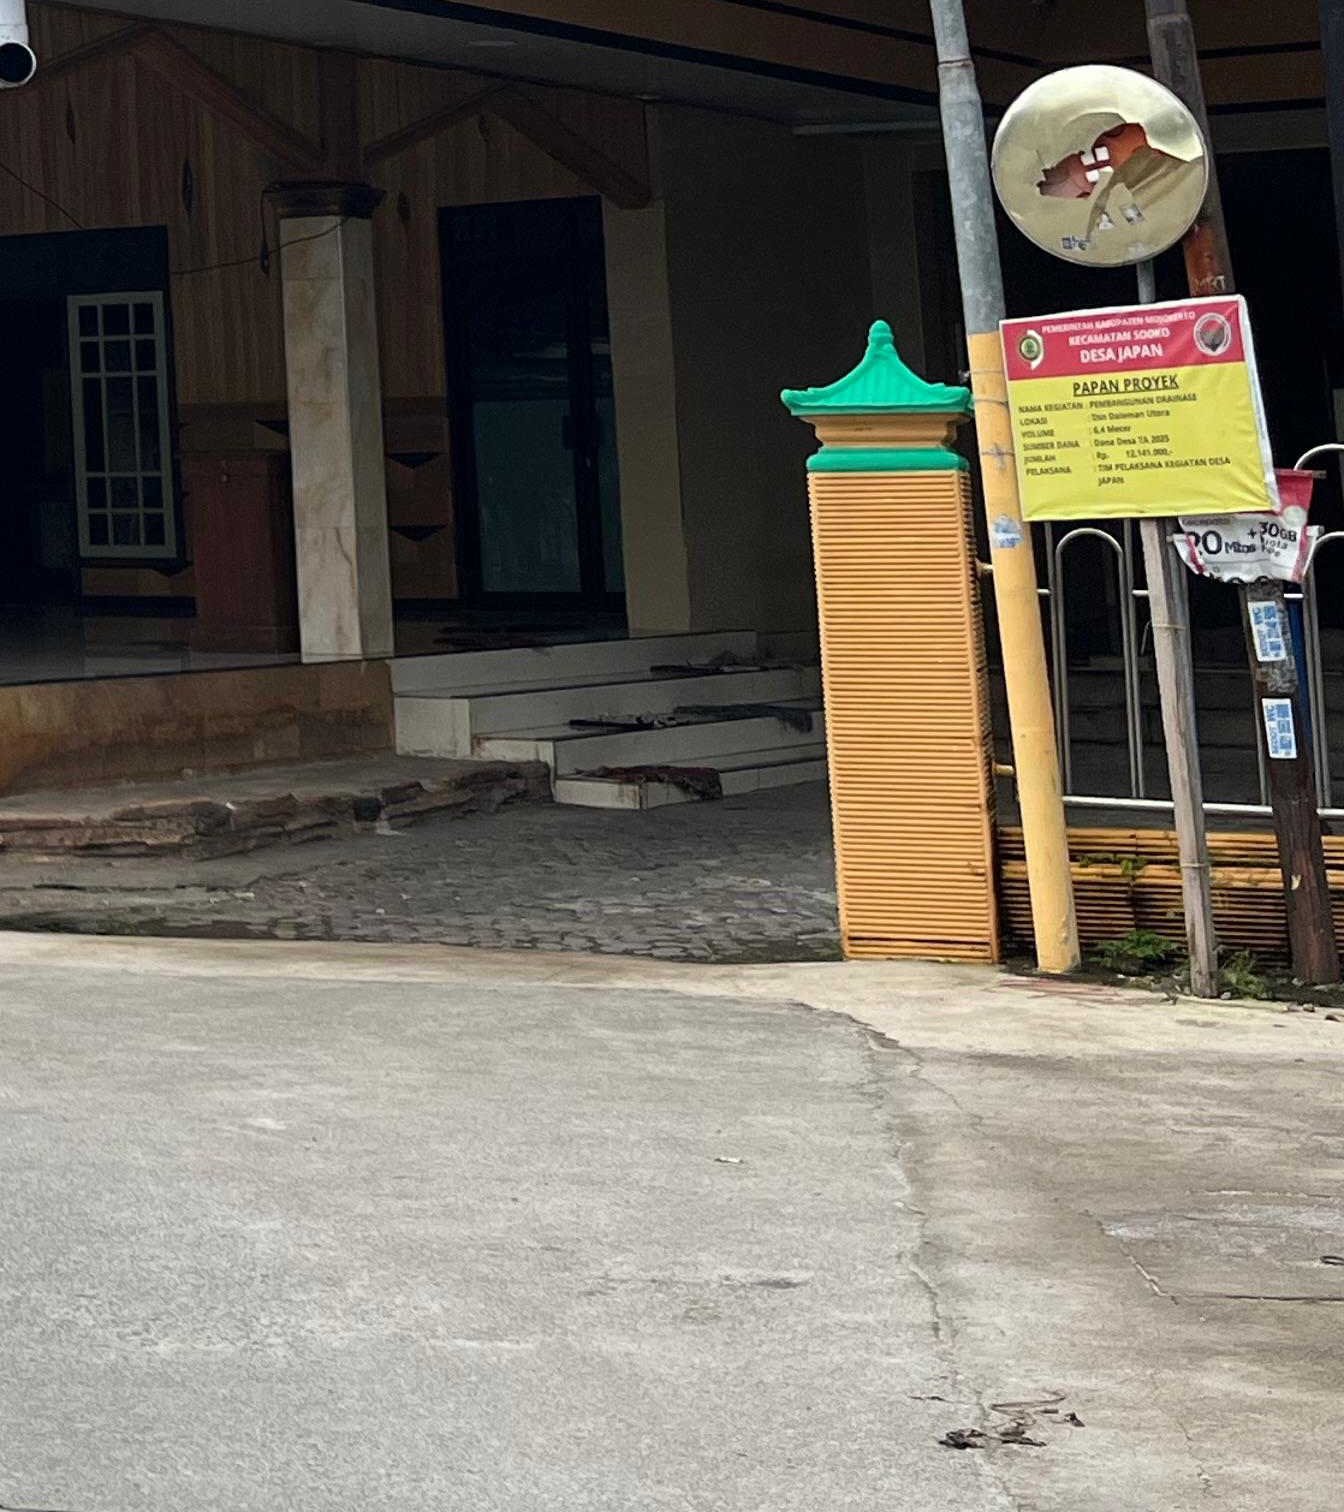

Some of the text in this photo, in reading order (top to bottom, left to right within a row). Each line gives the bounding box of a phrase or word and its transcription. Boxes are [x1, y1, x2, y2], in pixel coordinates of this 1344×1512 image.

[1069, 327, 1171, 346] KECAMATAN SOOKO
[1080, 343, 1164, 364] DESA JAPAN
[1073, 375, 1179, 396] PAPAN PROYEK
